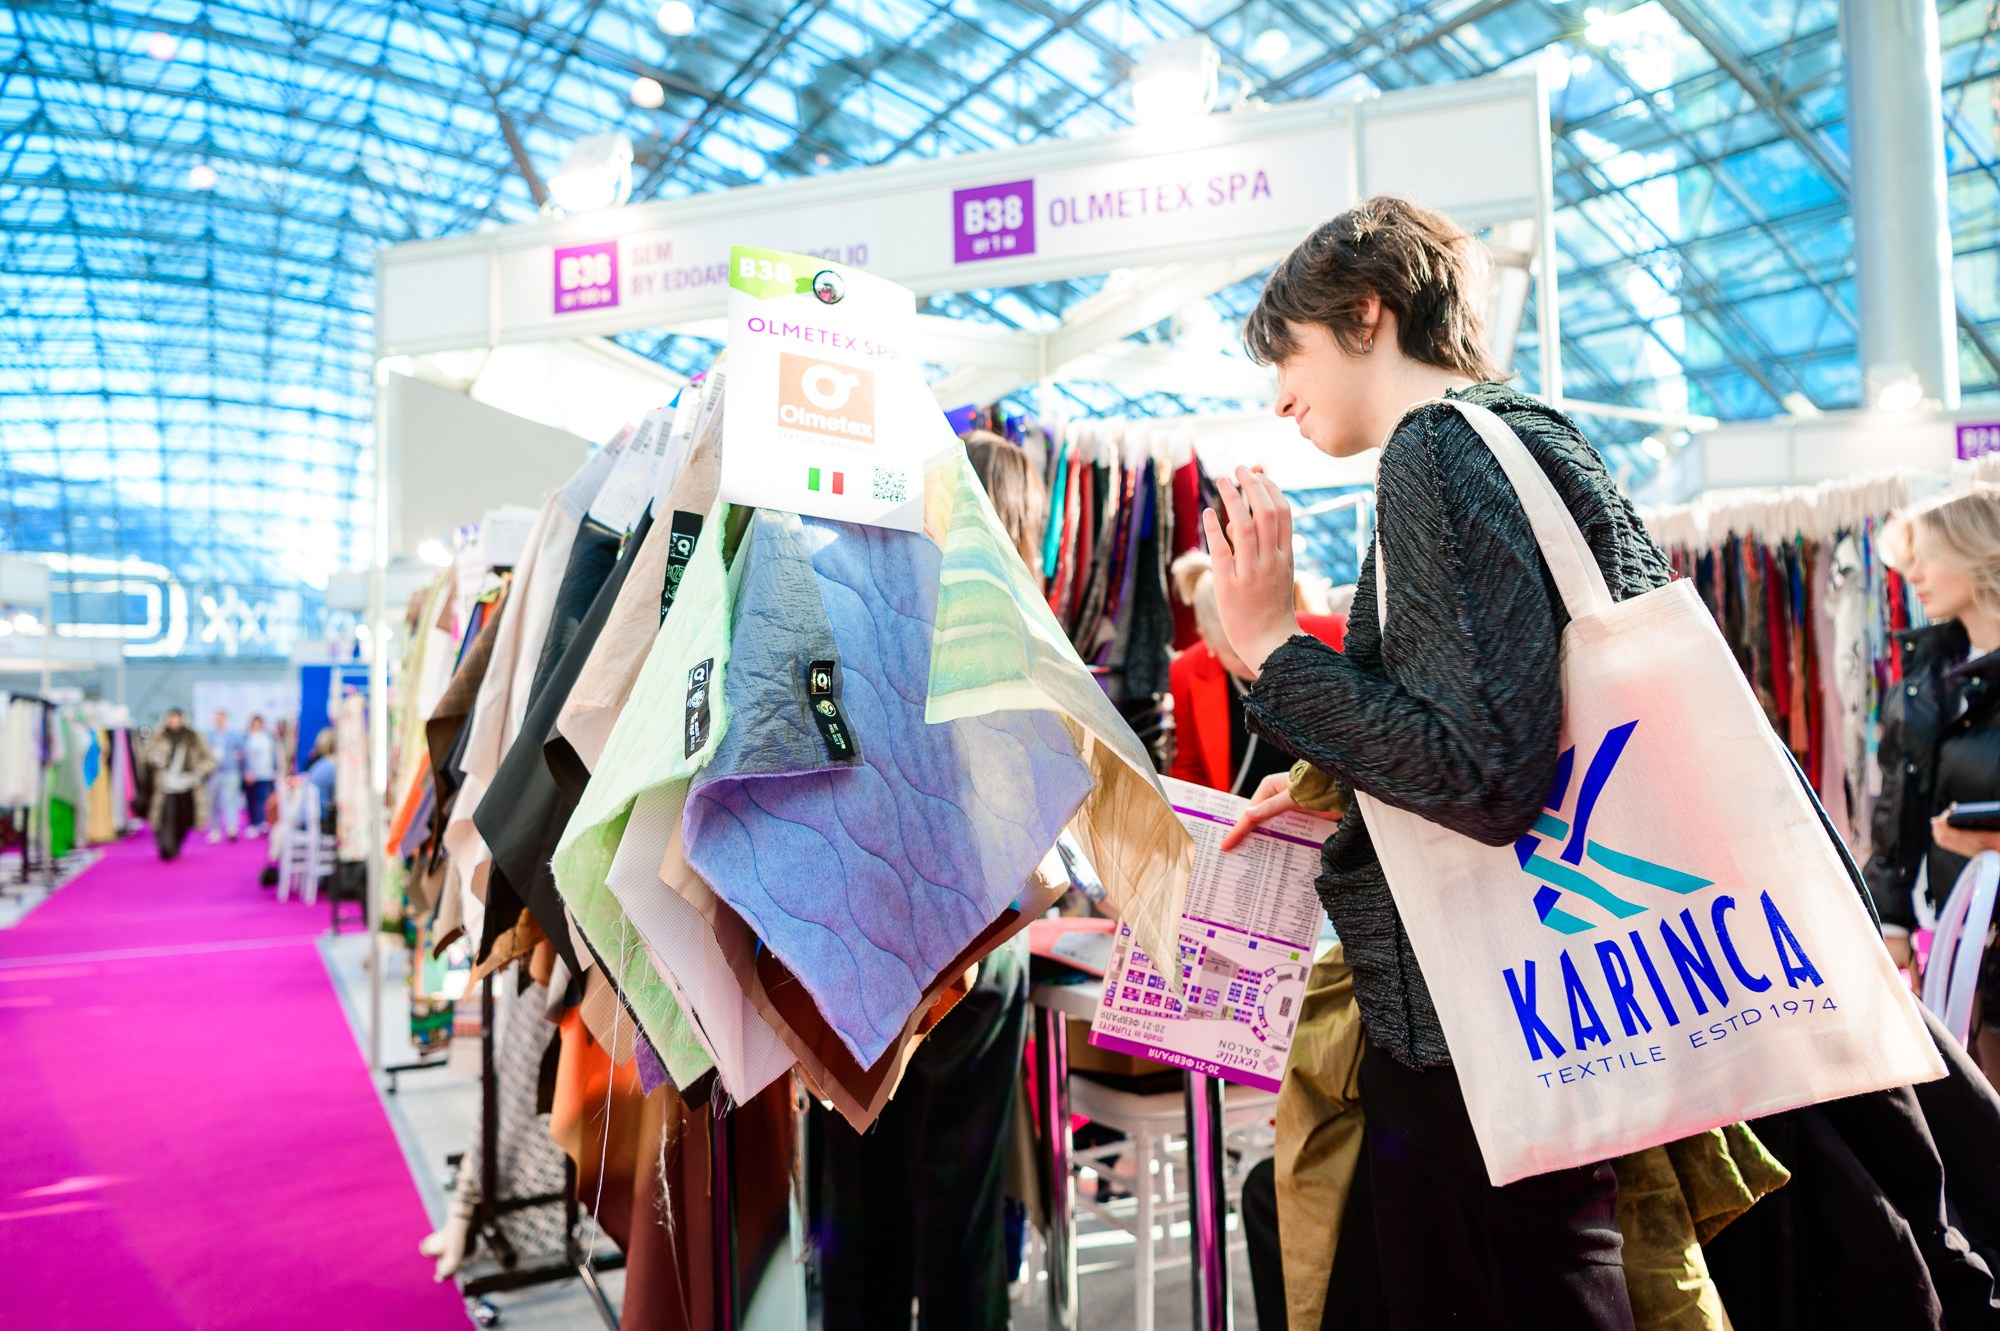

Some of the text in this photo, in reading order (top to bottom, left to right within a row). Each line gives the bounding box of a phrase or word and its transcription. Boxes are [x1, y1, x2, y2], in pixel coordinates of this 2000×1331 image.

[1049, 170, 1272, 227] OLMETEX SPA
[964, 195, 1023, 235] B38
[633, 242, 672, 266] SEM
[632, 273, 655, 296] BY
[664, 265, 729, 291] EDOAR
[739, 257, 793, 284] B38
[748, 317, 856, 351] OLMETEX
[780, 404, 874, 438] Olmetex
[1502, 889, 1824, 1062] KARINCA
[1100, 1009, 1166, 1033] 20-21 ФЕВРАЛЯ
[1144, 1034, 1164, 1043] made
[1219, 1039, 1262, 1058] SALON
[1537, 997, 1838, 1089] TEXTILE ESTD 1974
[1148, 1048, 1220, 1075] 20-21 ФЕВРАЛЯ
[1216, 1050, 1259, 1070] textile
